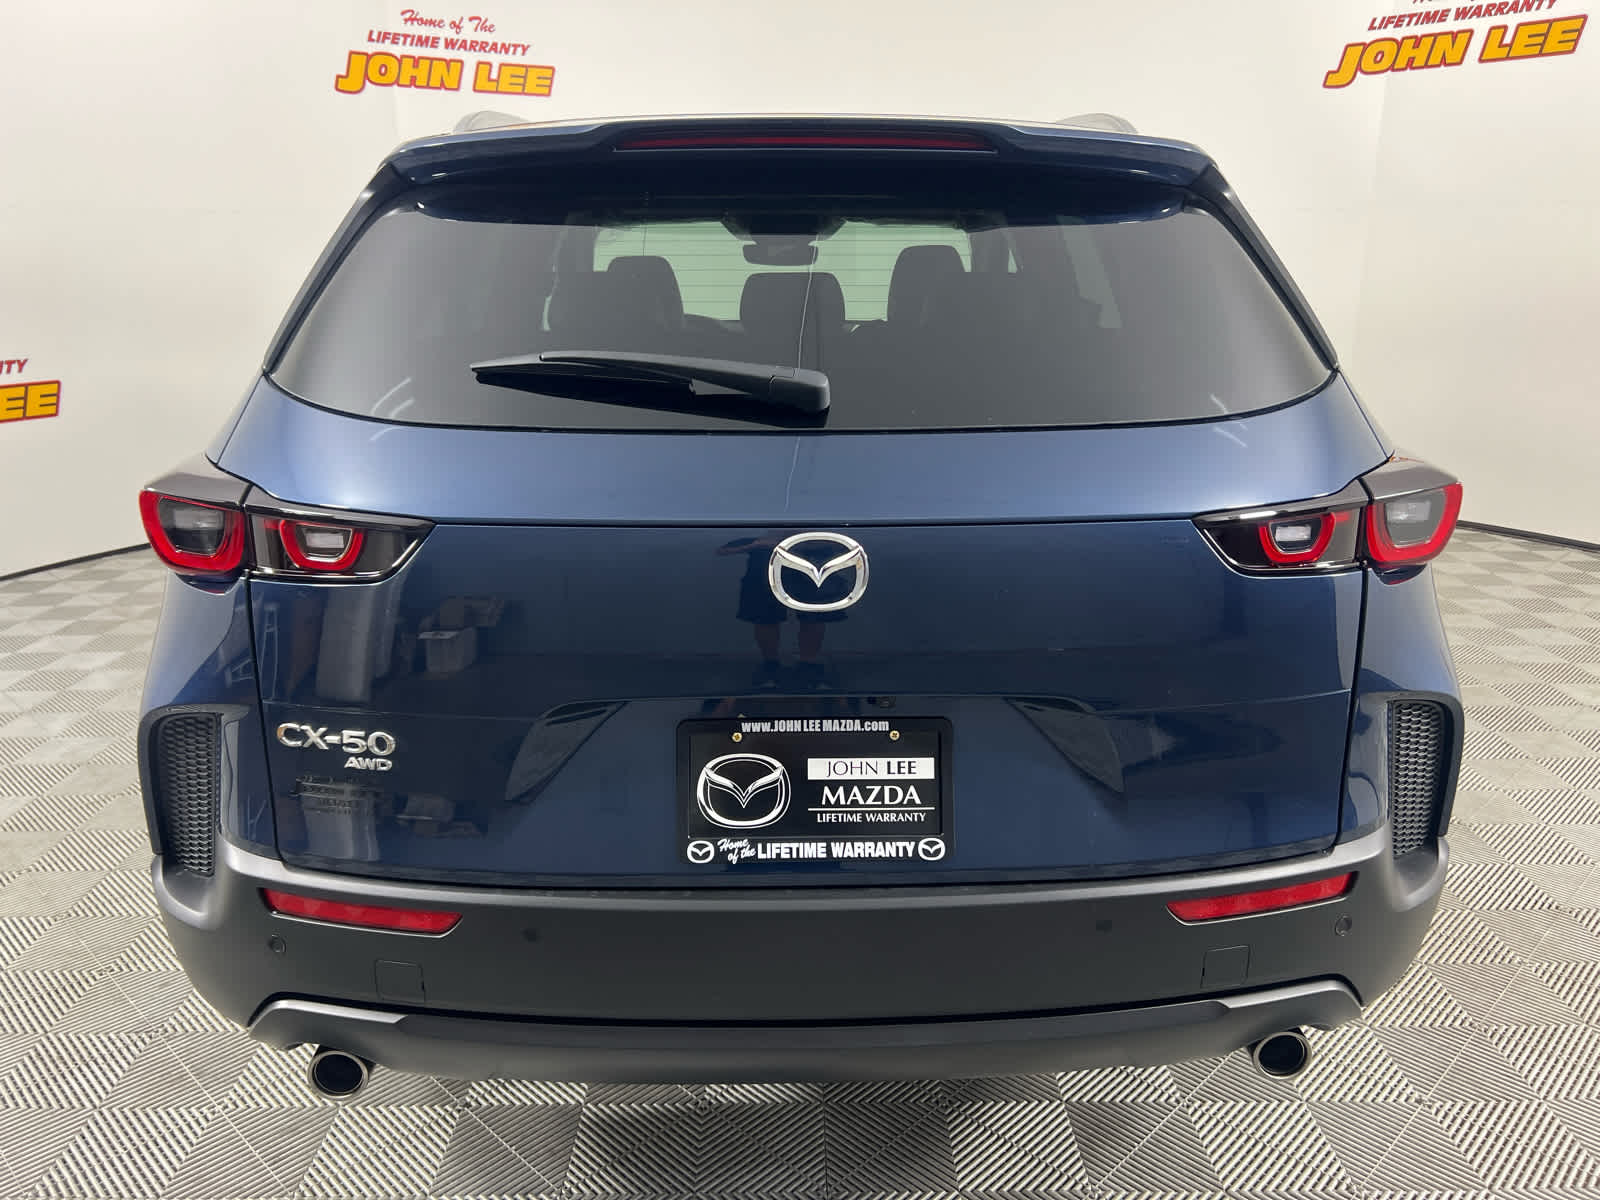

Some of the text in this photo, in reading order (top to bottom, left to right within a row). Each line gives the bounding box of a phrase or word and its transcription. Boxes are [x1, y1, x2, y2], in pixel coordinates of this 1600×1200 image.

[400, 9, 496, 34] Home of The
[1367, 0, 1557, 31] LIFETIME WARRANTY
[367, 30, 530, 56] LIFETIME WARRANTY
[1322, 14, 1588, 88] JOHN LEE
[335, 50, 555, 97] JOHN LEE
[0, 380, 61, 424] EE
[803, 719, 821, 732] LEE
[822, 719, 889, 732] MAZDA.com
[276, 722, 396, 756] CX-50
[344, 756, 393, 771] AWD
[826, 760, 917, 778] JOHN LEE
[821, 785, 921, 805] MAZDA
[817, 812, 926, 823] LIFETIME WARRANTY
[717, 838, 748, 853] Home
[728, 844, 757, 865] of the
[757, 841, 915, 859] LIFETIME WARRANTY
